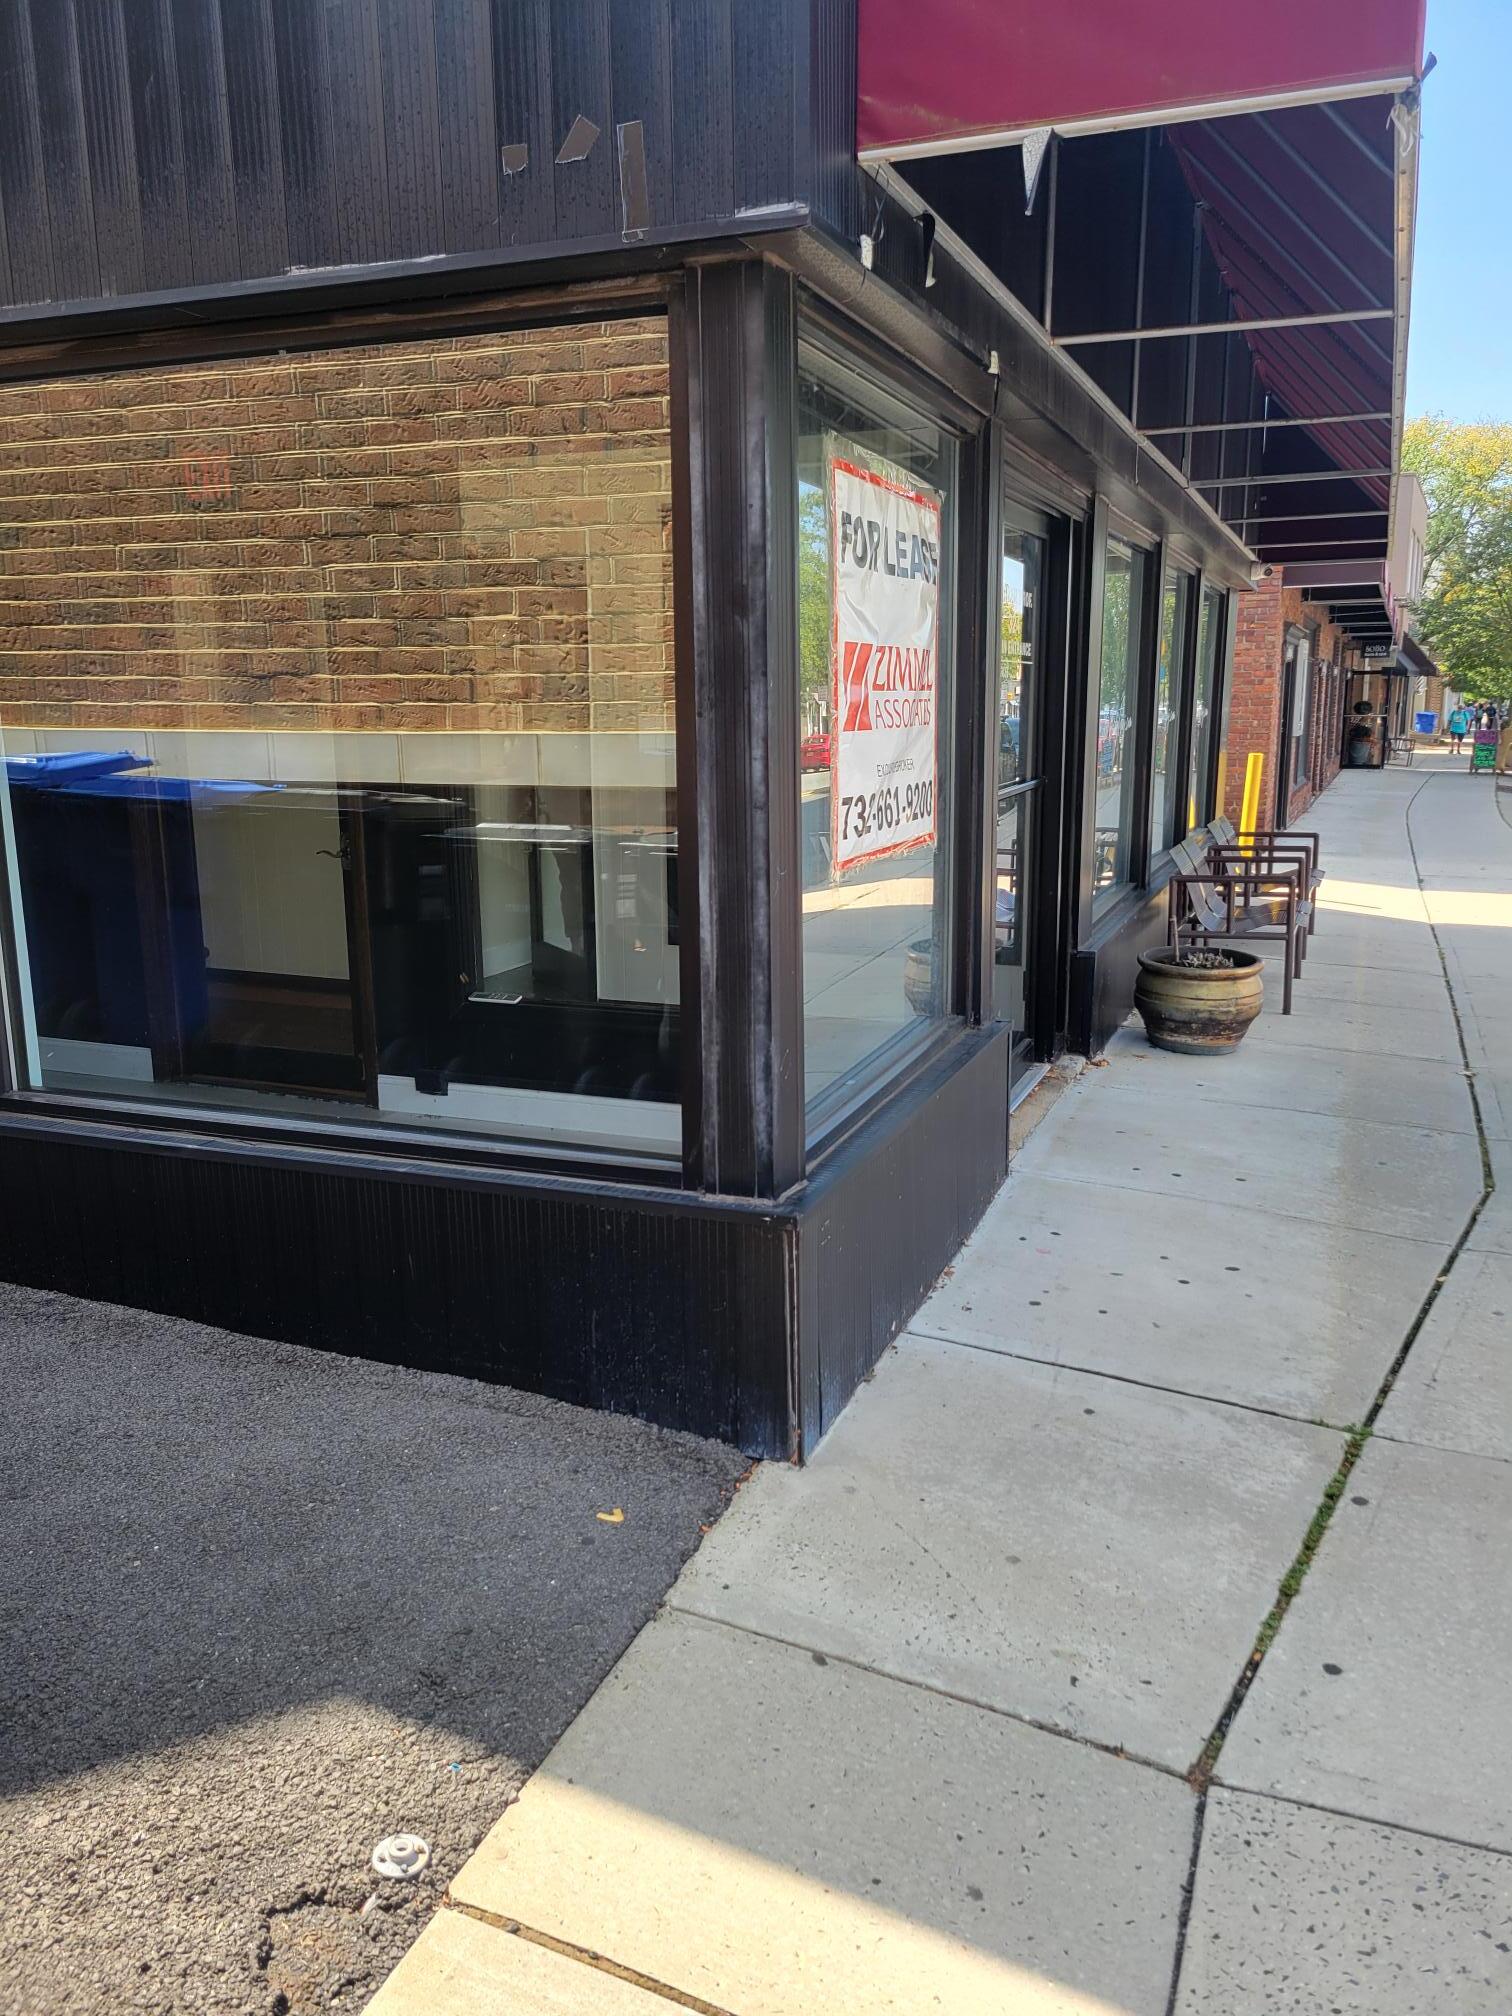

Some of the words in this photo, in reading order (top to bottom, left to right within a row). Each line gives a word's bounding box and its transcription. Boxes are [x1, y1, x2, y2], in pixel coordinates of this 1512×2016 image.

[841, 511, 880, 573] FOR
[883, 526, 937, 585] LEASE
[841, 780, 932, 840] 732-661-9200
